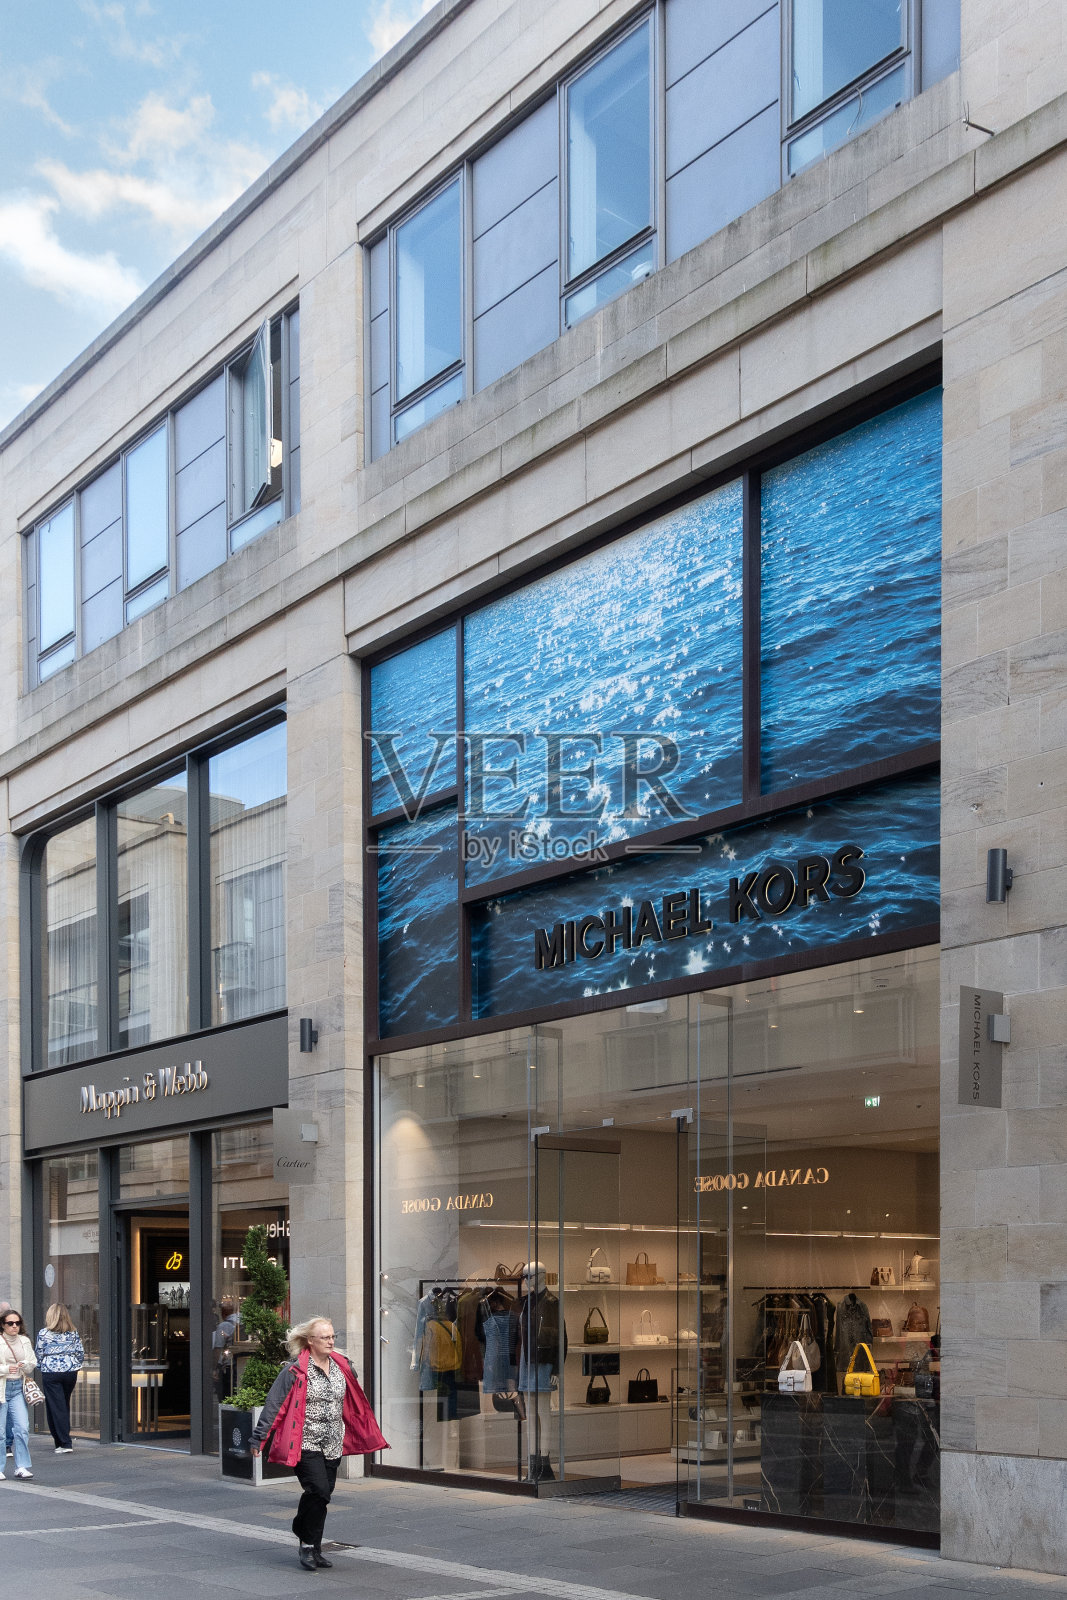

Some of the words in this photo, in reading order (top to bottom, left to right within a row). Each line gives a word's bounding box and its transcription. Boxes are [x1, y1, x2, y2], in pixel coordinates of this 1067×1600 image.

[534, 887, 713, 970] MICHAEL
[729, 845, 866, 923] KORS
[973, 994, 981, 1056] MICHAEL
[80, 1076, 139, 1119] Mappin
[142, 1072, 157, 1101] &
[158, 1060, 208, 1097] Webb
[972, 1062, 981, 1100] KORS
[276, 1156, 311, 1168] Cartier
